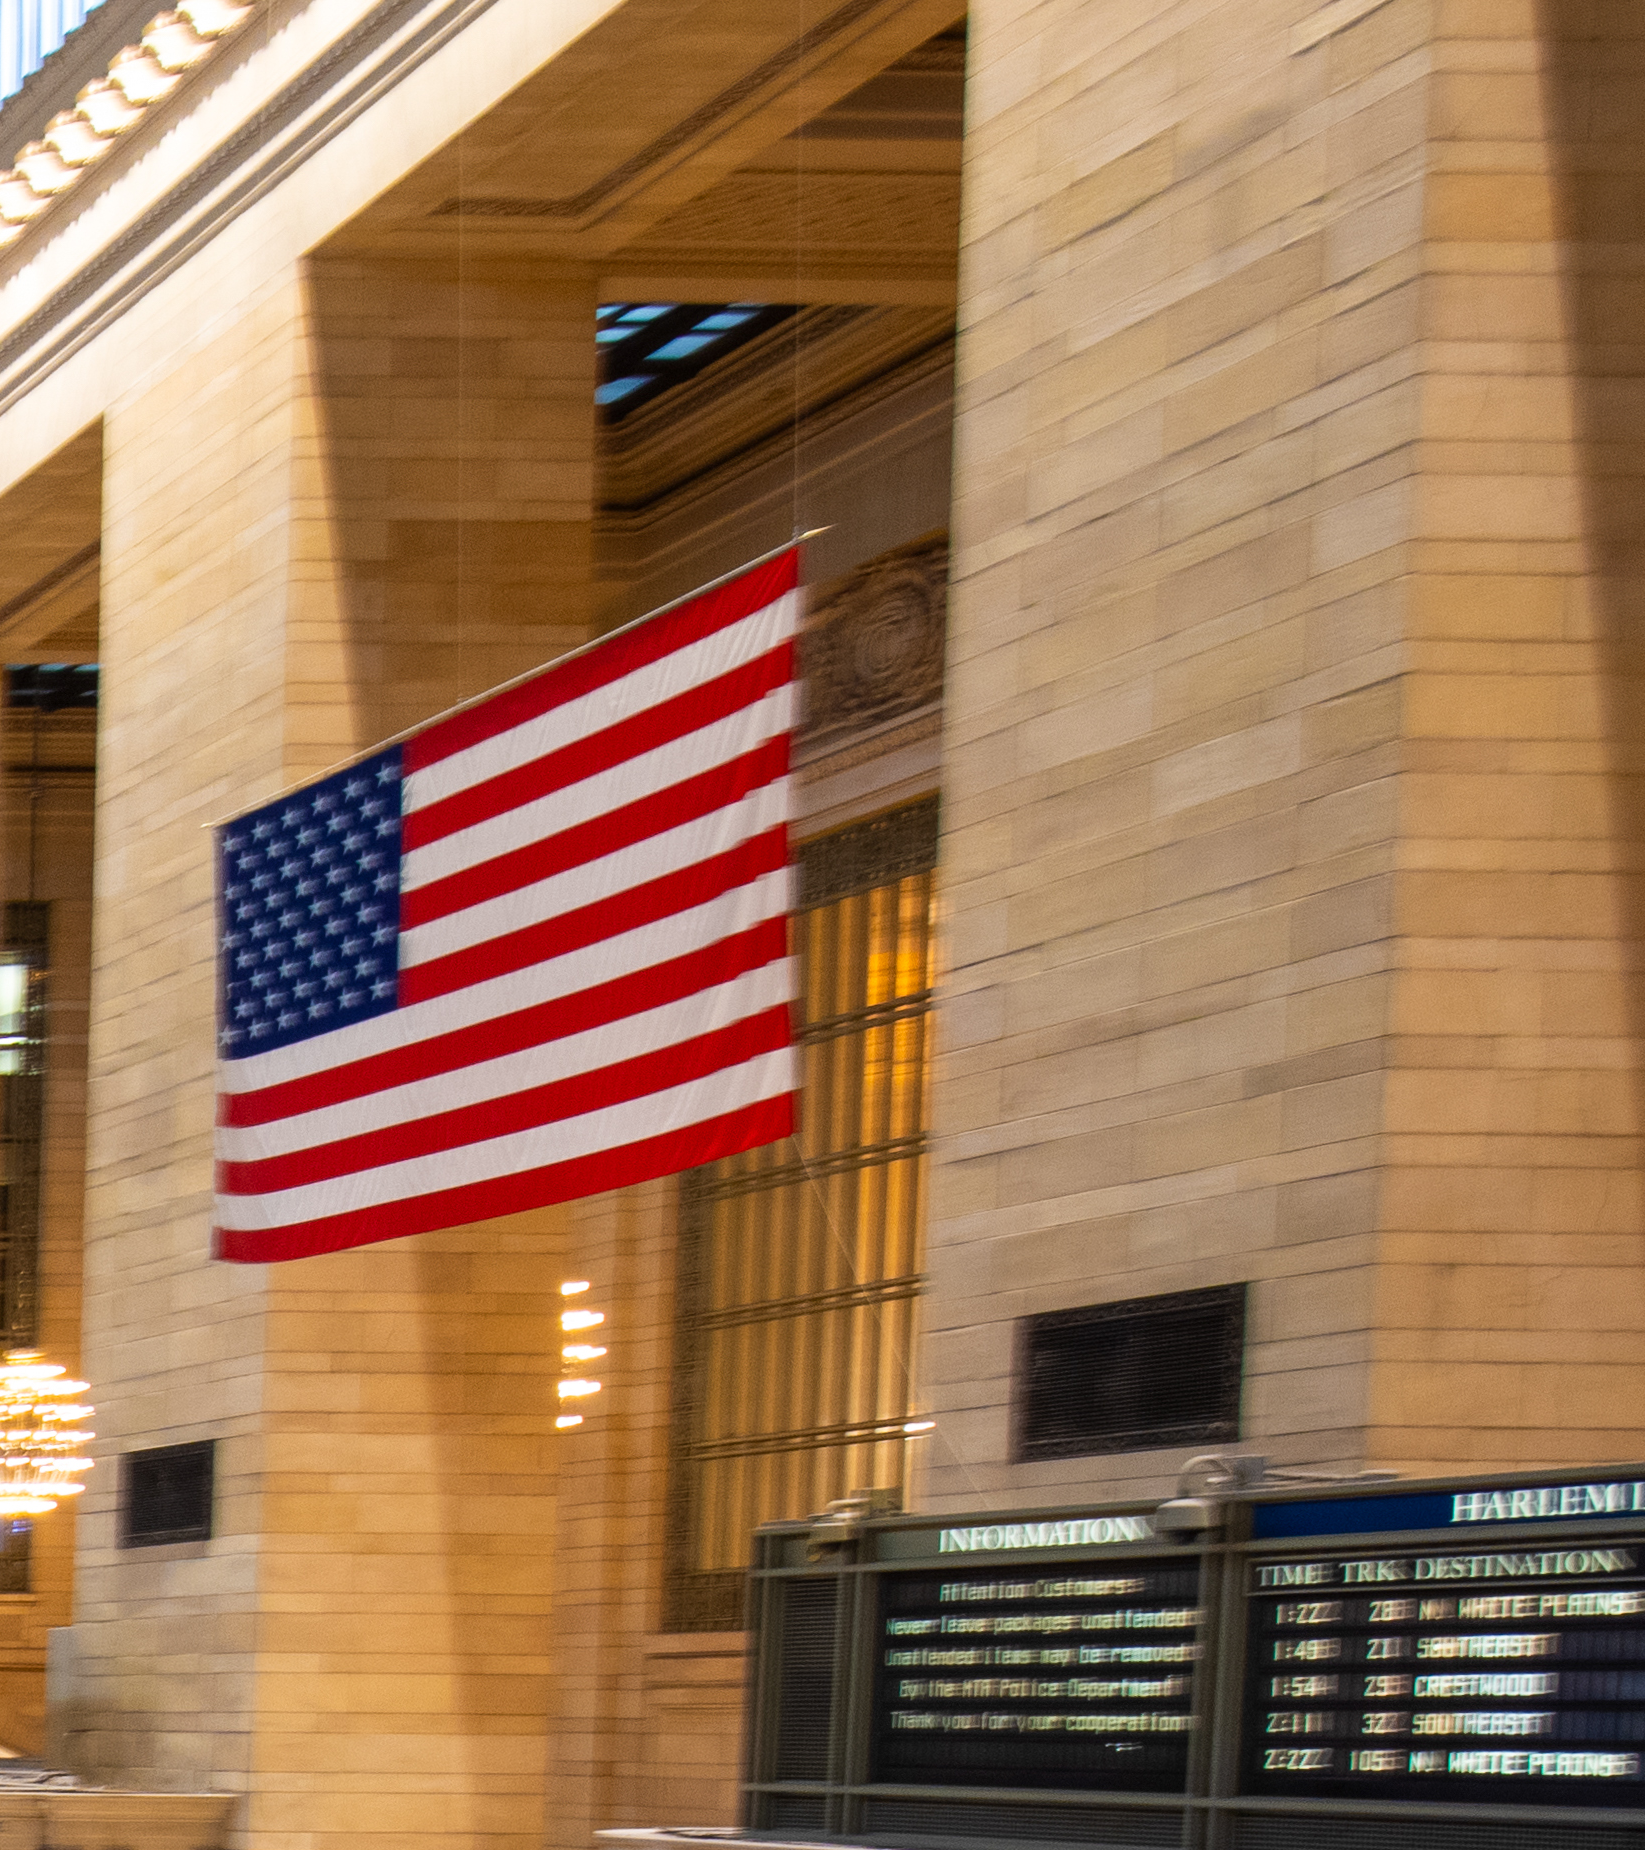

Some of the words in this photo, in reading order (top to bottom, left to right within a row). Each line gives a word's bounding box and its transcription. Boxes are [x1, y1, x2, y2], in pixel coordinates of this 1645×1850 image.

[1449, 1484, 1631, 1522] HARLEM
[938, 1516, 1153, 1553] INFORMATION
[1255, 1563, 1335, 1587] TIME
[1339, 1560, 1410, 1583] TRK
[1414, 1550, 1634, 1580] DESTINATION
